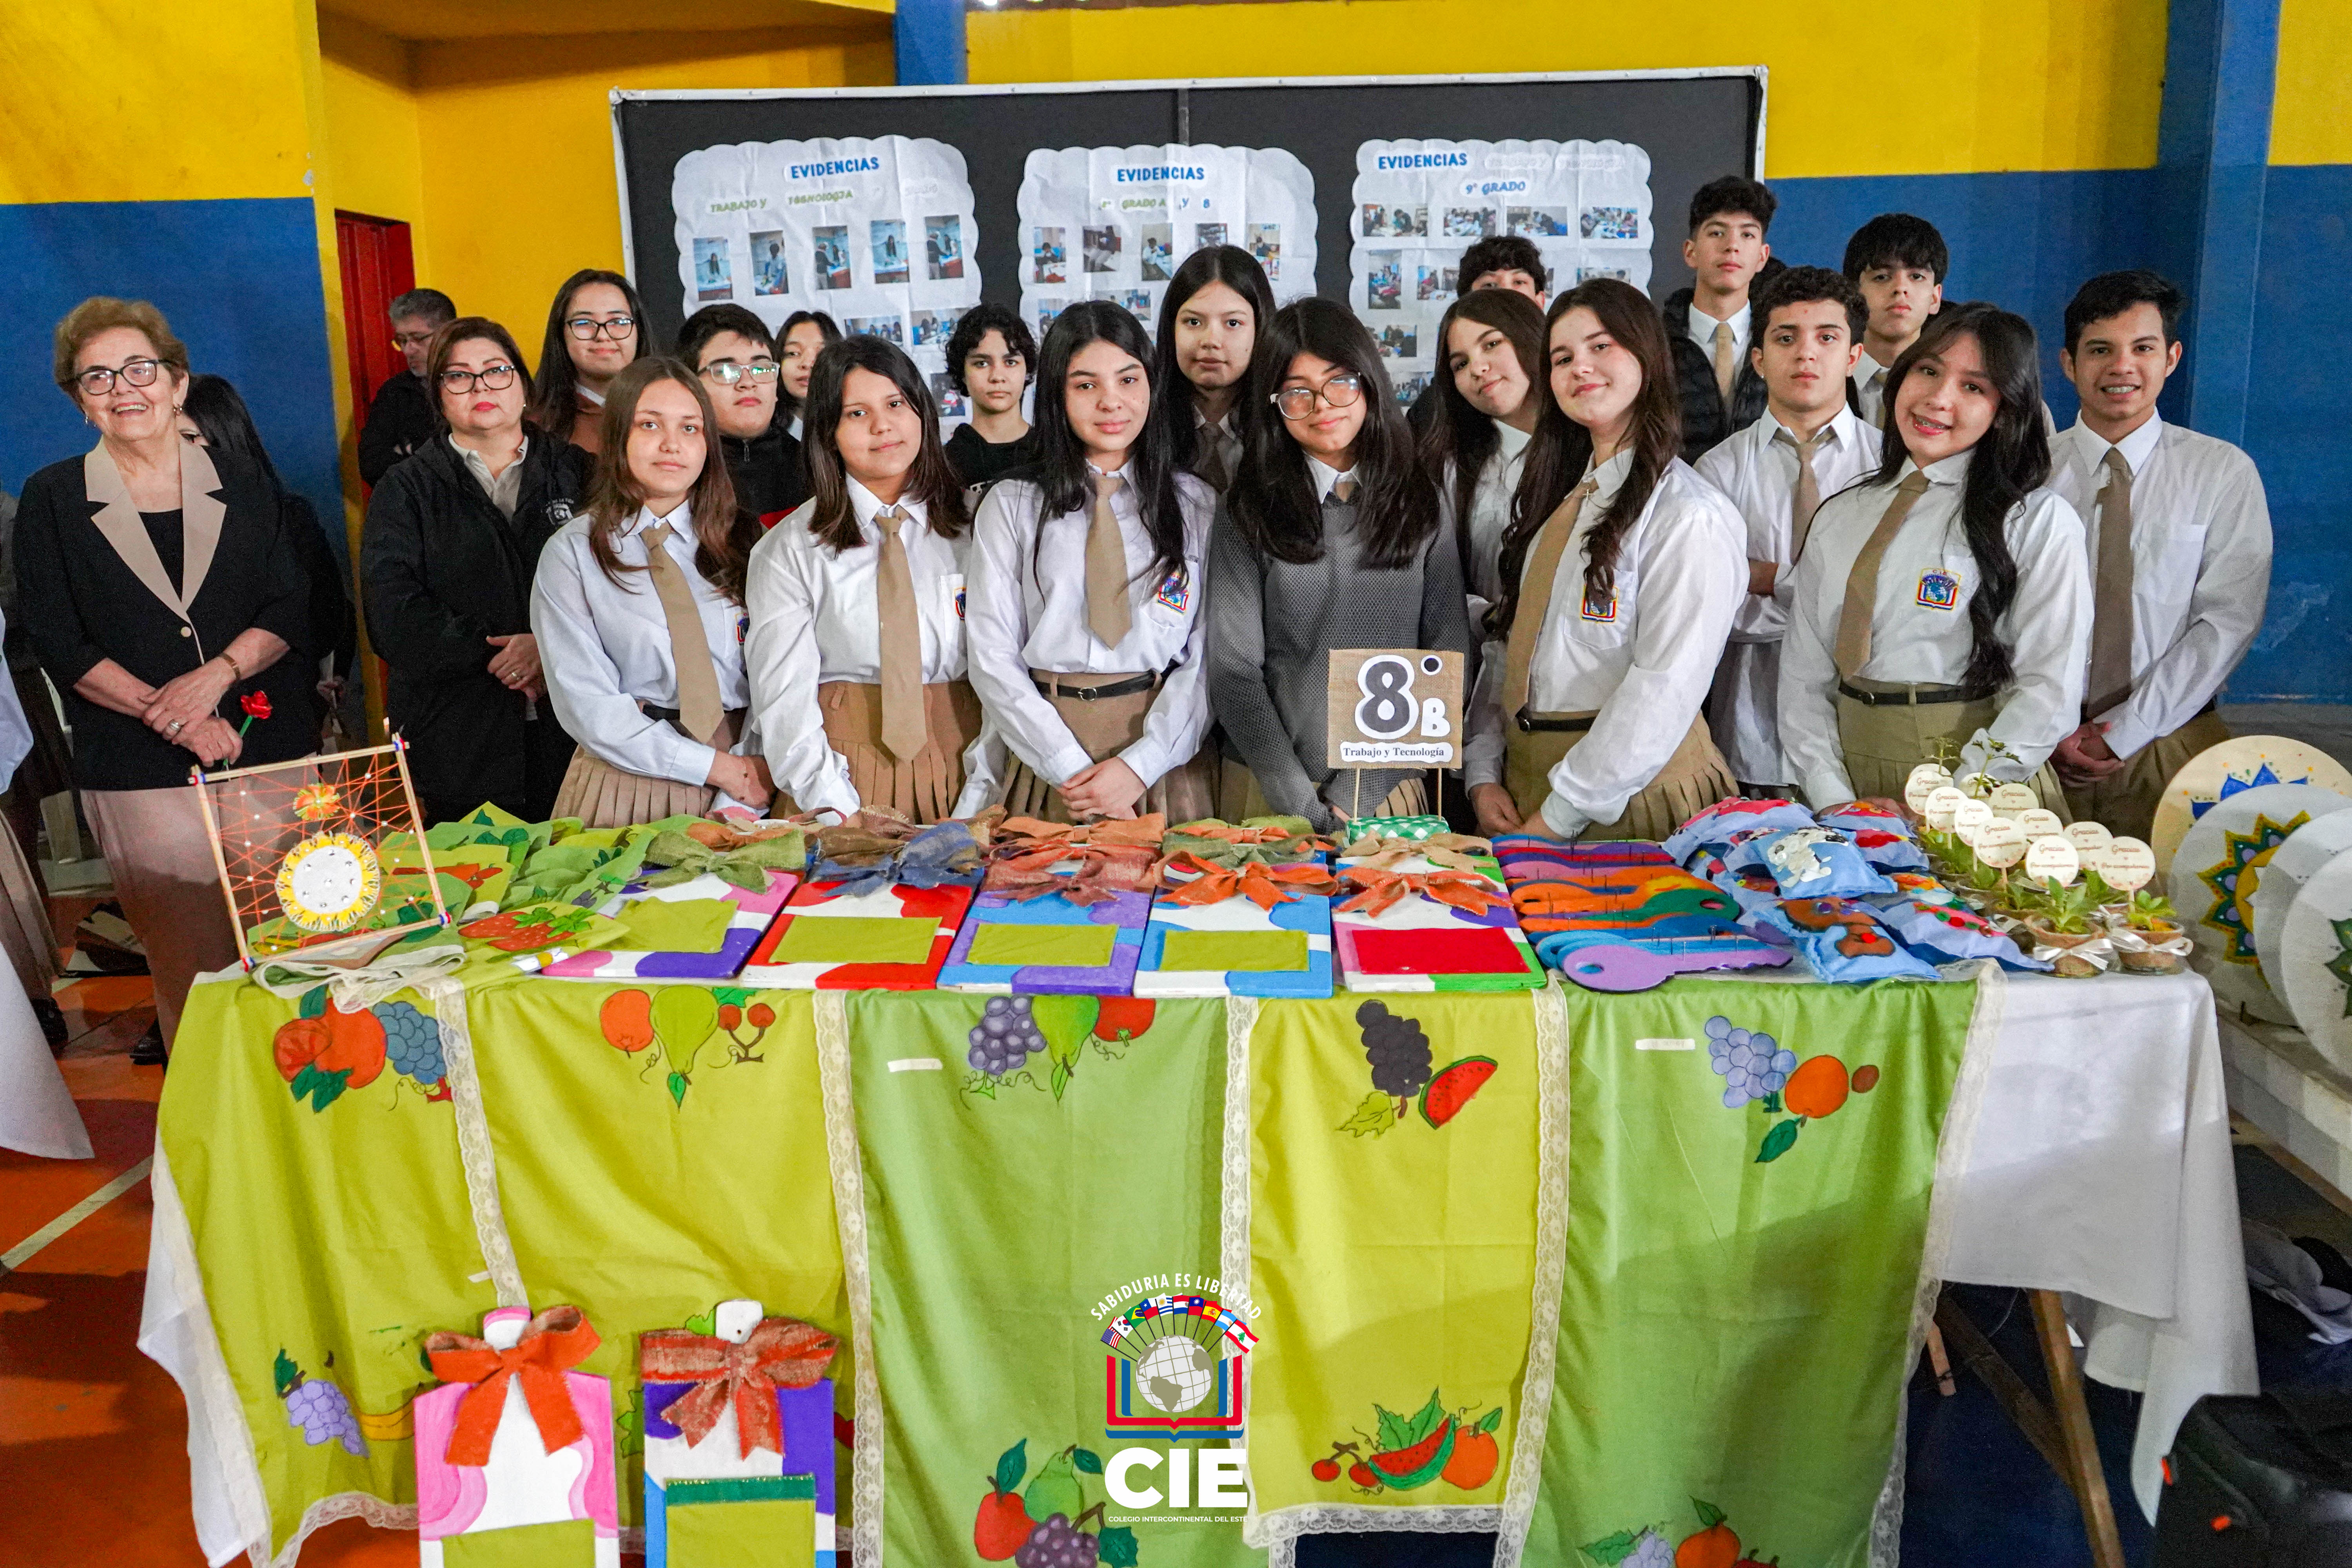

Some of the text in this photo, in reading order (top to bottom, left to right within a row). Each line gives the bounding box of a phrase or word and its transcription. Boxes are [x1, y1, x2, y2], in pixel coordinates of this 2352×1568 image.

[1379, 152, 1467, 169] EVIDENCIAS
[791, 157, 879, 179] EVIDENCIAS
[1117, 166, 1205, 182] EVIDENCIAS
[1482, 181, 1526, 195] GRADO
[711, 200, 757, 212] TRABAJO
[1421, 698, 1450, 737] B
[1343, 747, 1444, 758] Trabajo y Tecnología
[1936, 793, 1959, 802] Gracias
[2001, 789, 2027, 799] Gracias
[2024, 815, 2050, 824] Gracias
[1985, 825, 2011, 835] Gracias
[2072, 828, 2100, 837] Gracias
[2039, 844, 2066, 854] Gracias
[2111, 844, 2141, 855] Gracias
